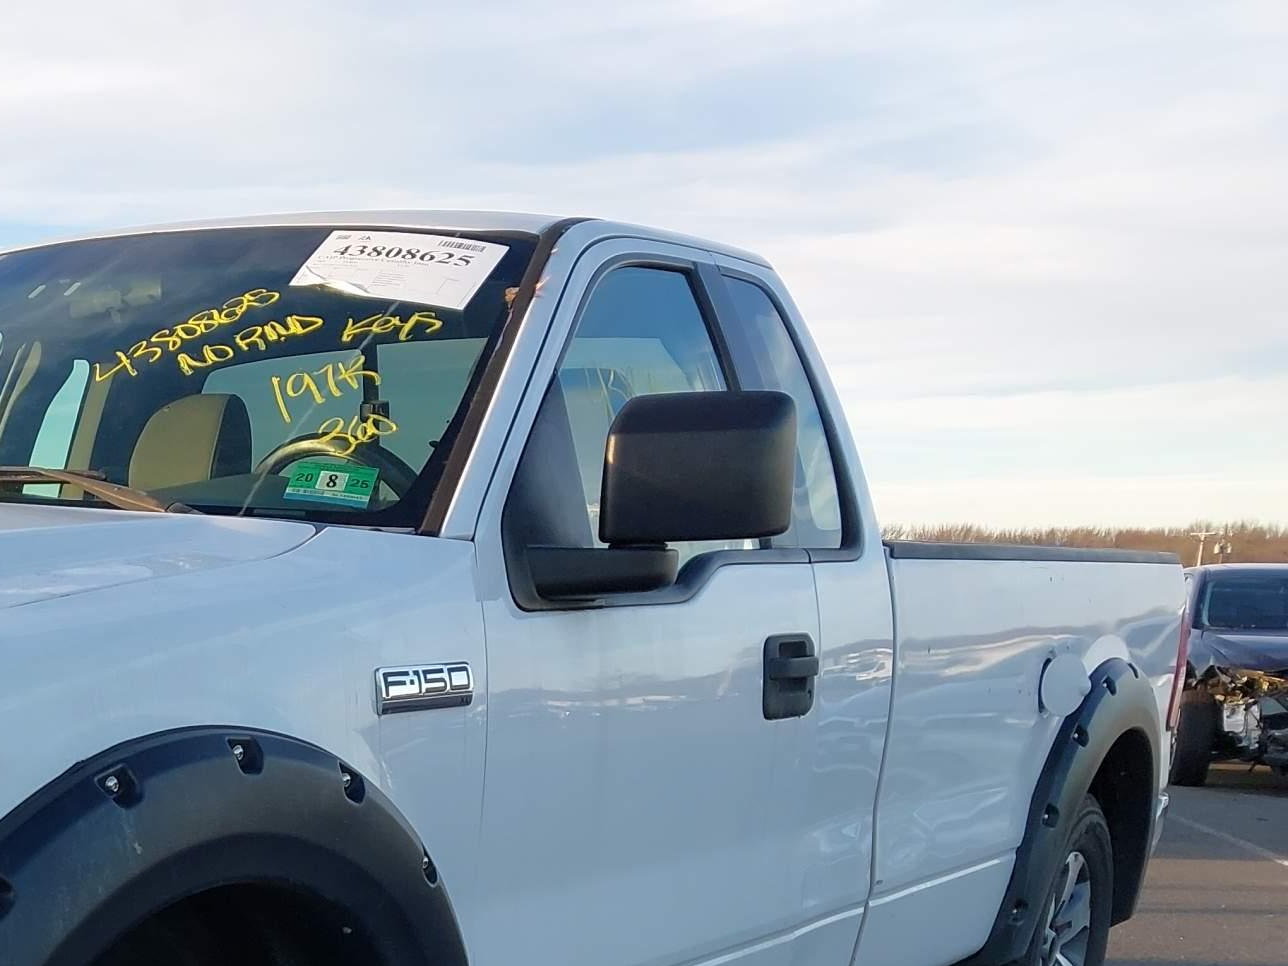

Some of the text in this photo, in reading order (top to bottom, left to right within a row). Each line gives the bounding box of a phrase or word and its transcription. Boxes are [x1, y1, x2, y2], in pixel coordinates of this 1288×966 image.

[332, 244, 476, 268] 43808625
[93, 288, 281, 383] 43808625
[271, 354, 382, 424] 197K
[295, 472, 314, 483] 20
[326, 473, 338, 489] 8
